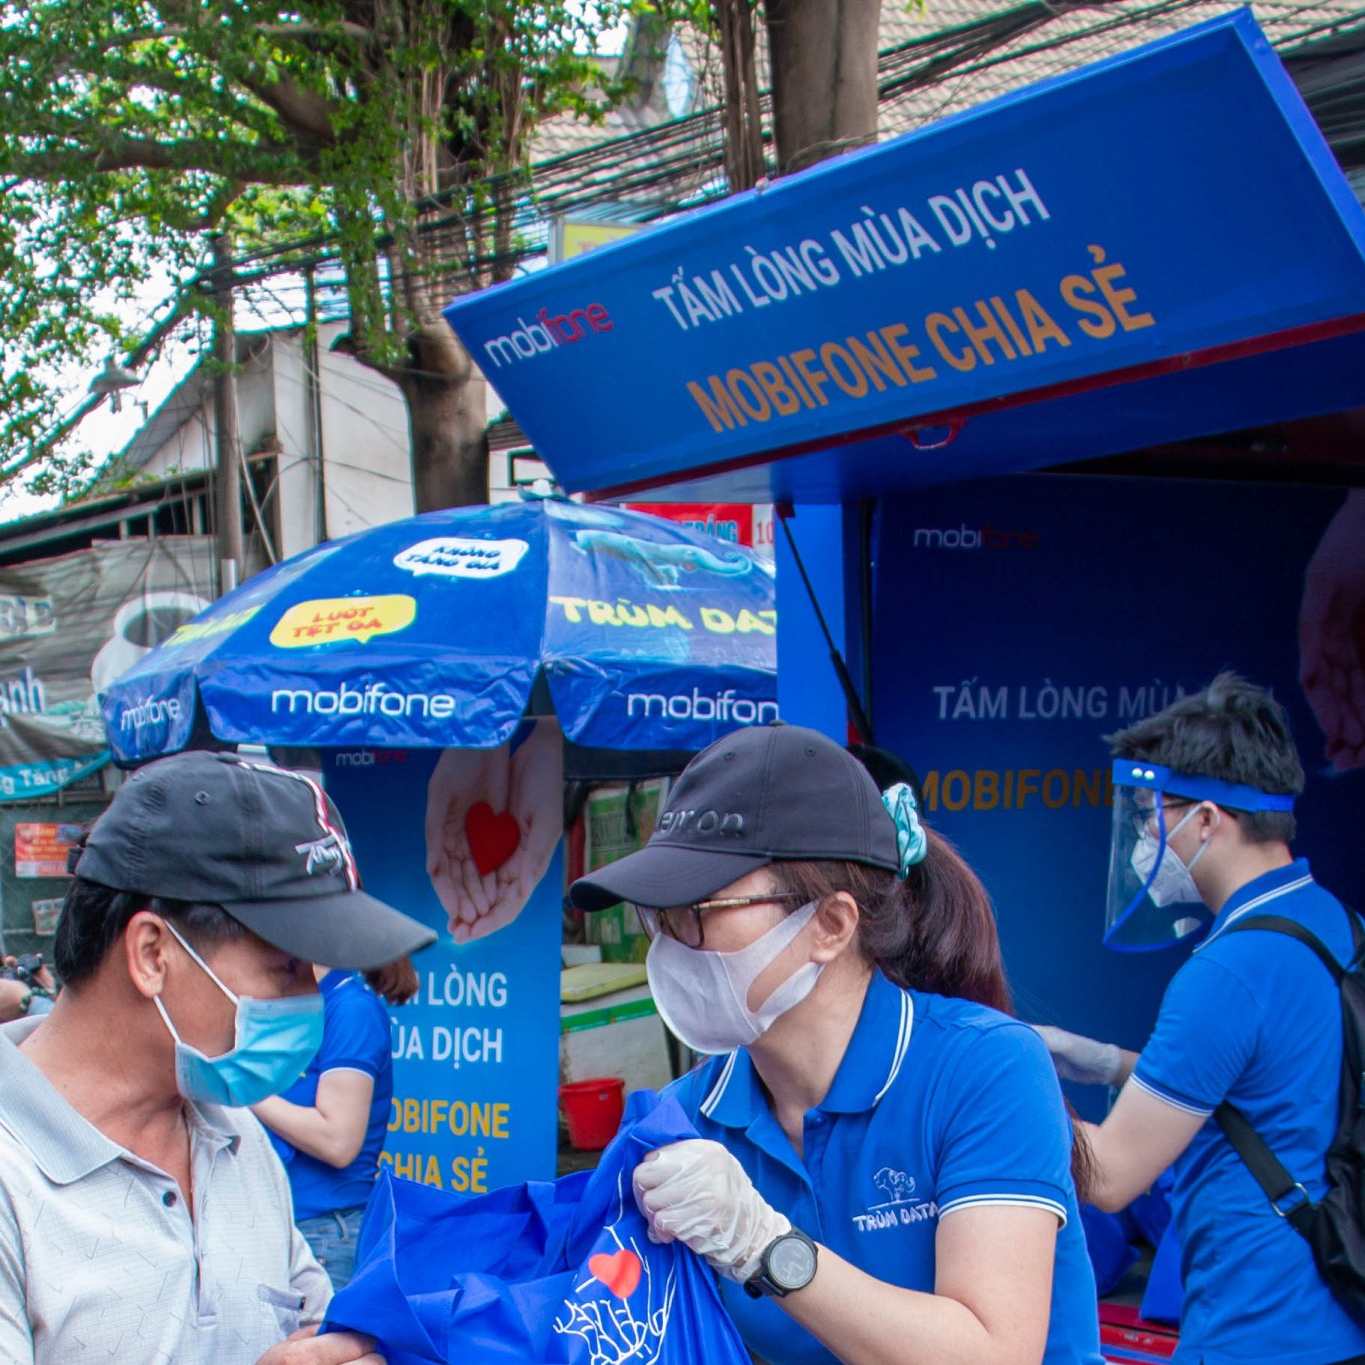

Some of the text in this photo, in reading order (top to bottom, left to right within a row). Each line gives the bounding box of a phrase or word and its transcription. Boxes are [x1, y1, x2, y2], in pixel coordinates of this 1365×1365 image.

[653, 168, 1051, 330] TẤM LÒNG MÙA DỊCH
[484, 302, 615, 368] mobifone
[686, 244, 1156, 434] MOBIFONE CHIA SẺ
[700, 606, 778, 636] DAT
[272, 682, 456, 718] mobifone
[628, 687, 779, 724] mobifon
[933, 675, 1008, 720] TẤM
[1019, 677, 1107, 719] LÒNG
[922, 768, 1113, 812] MOBIFON
[428, 963, 508, 1008] LÒNG
[391, 1016, 503, 1070] ÙA DỊCH
[387, 1098, 511, 1139] OBIFONE
[451, 1146, 488, 1194] SẺ
[852, 1200, 939, 1232] TRÙM DATA
